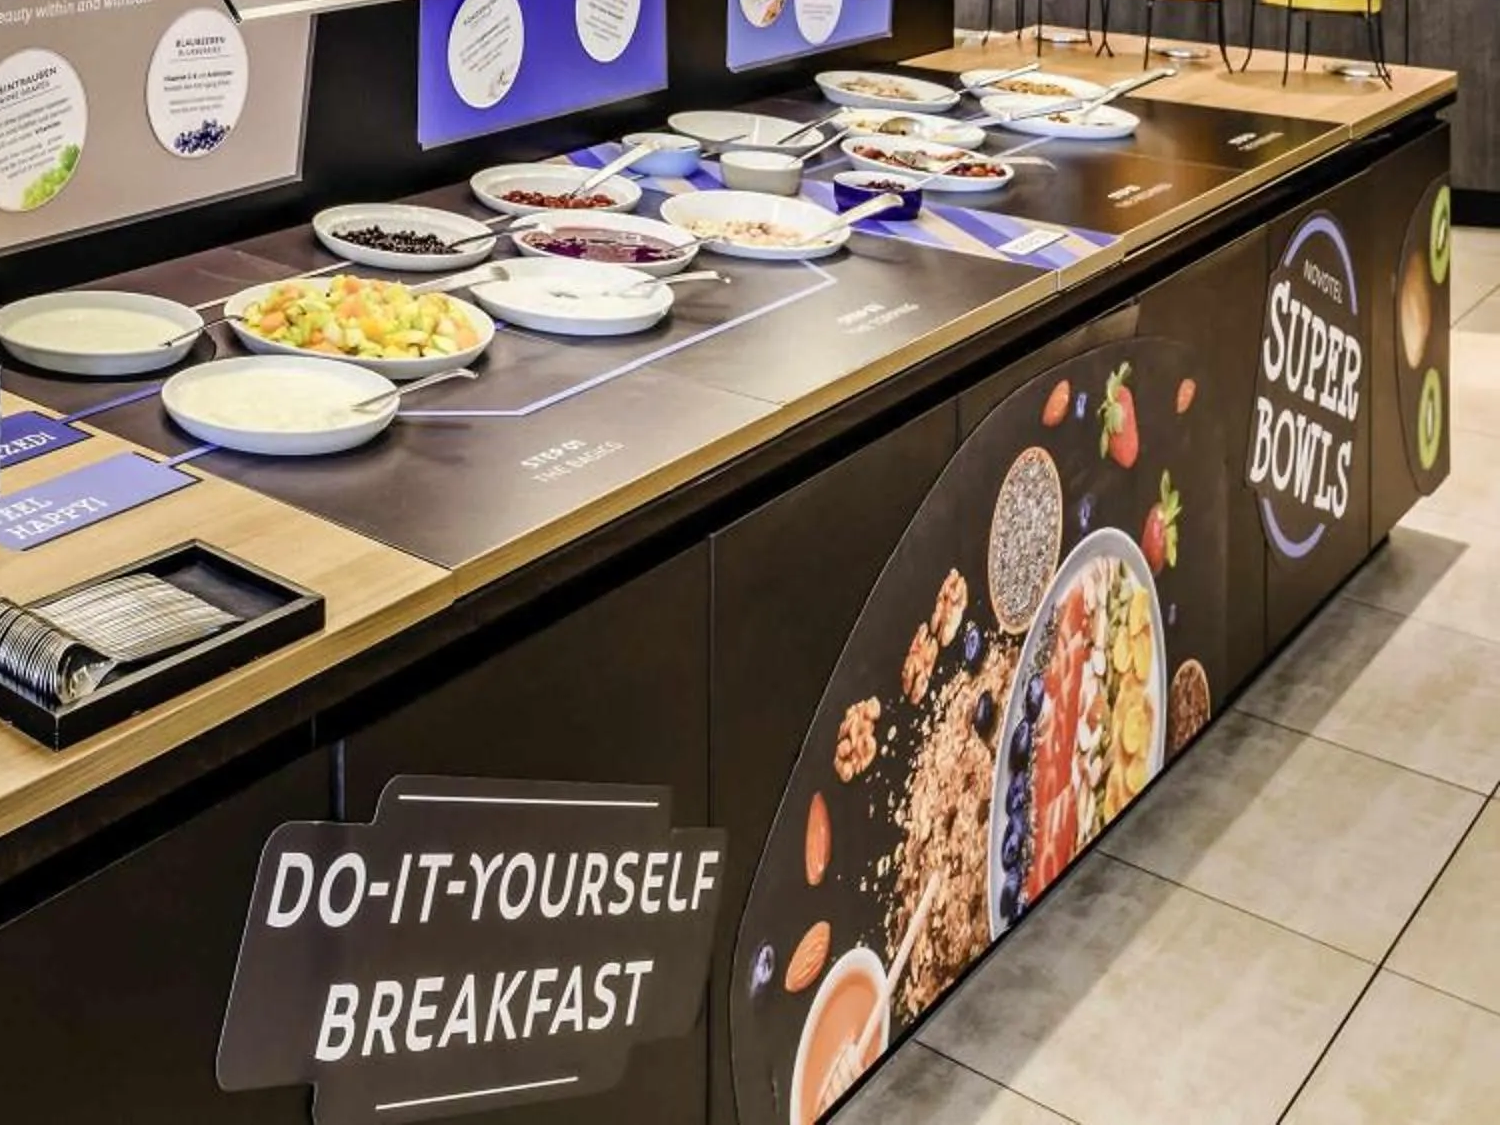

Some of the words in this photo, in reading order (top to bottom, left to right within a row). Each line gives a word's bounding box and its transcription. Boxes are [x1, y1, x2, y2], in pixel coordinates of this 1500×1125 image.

[36, 1, 75, 18] within
[1303, 258, 1343, 304] NOVOTEL
[1263, 279, 1361, 421] SUPER
[1250, 396, 1352, 519] BOWLS
[5, 496, 108, 540] HAPPY!
[266, 850, 719, 928] DO-IT-YOURSELF
[315, 959, 654, 1062] BREAKFAST
